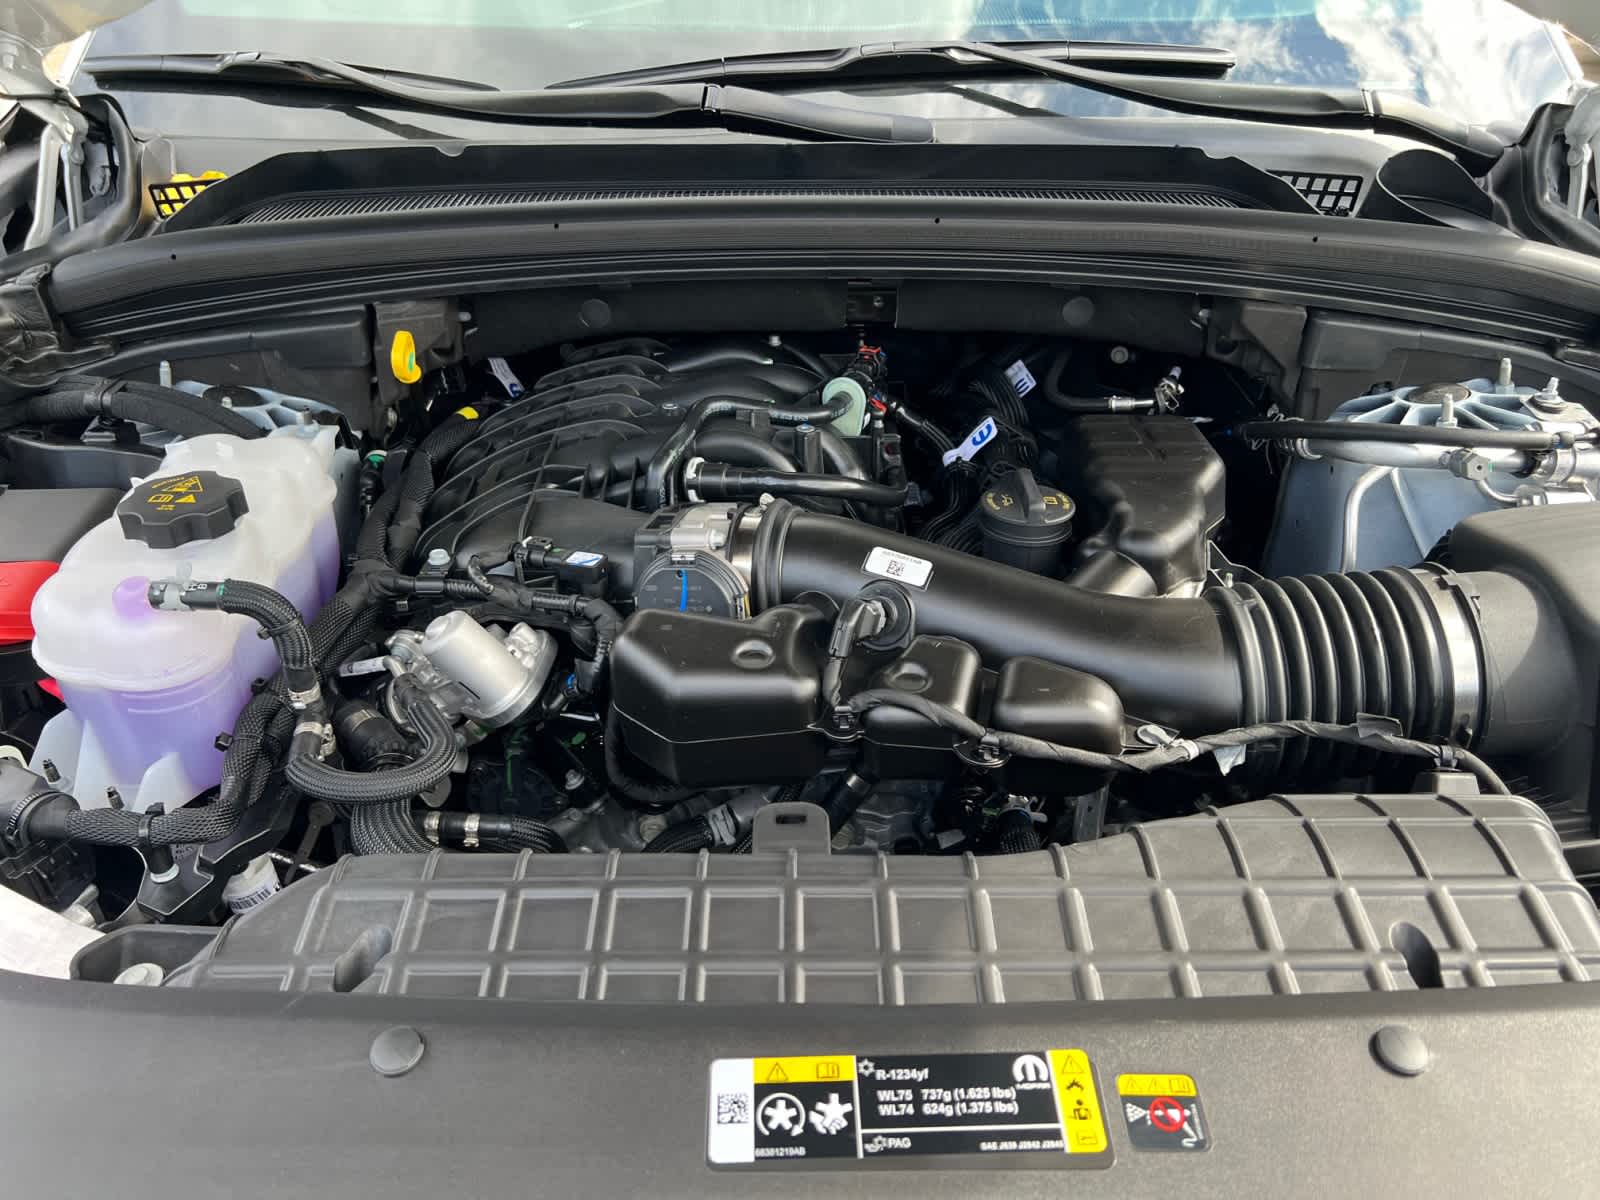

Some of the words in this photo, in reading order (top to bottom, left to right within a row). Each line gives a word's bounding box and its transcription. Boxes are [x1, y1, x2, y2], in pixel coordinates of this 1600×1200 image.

[875, 1068, 929, 1082] R-1234yf
[876, 1089, 913, 1101] WL75
[920, 1088, 952, 1102] 737g
[953, 1087, 991, 1101] (1.625
[992, 1086, 1017, 1100] lbs)
[878, 1103, 915, 1116] WL74
[922, 1102, 954, 1117] 624g
[955, 1101, 993, 1116] (1.375
[994, 1100, 1019, 1115] lbs)
[887, 1136, 912, 1148] PAG
